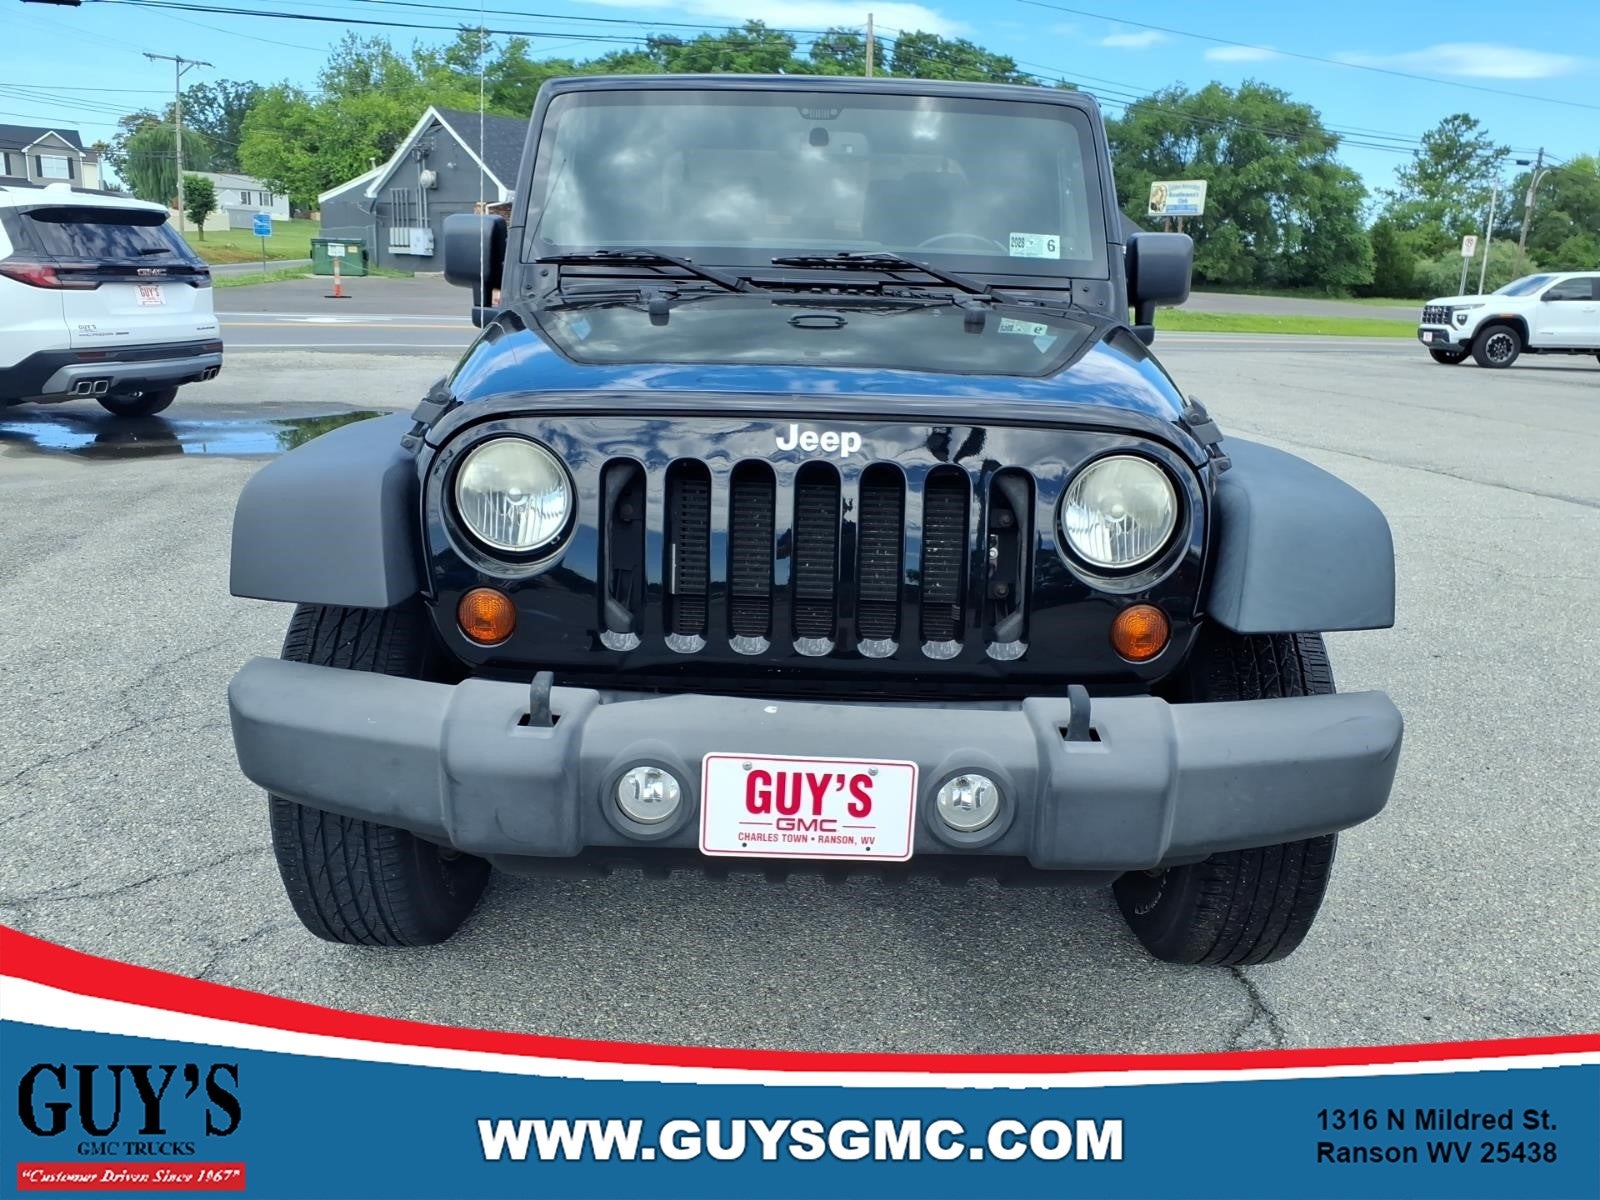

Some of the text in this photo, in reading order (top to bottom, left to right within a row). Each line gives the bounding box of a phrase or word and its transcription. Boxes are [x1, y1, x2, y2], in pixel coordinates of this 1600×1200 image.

[1047, 239, 1056, 252] 6
[140, 287, 160, 297] GUY'S
[776, 424, 862, 458] Jeep
[746, 770, 873, 818] GUY'S
[776, 818, 837, 832] GMC
[738, 832, 876, 846] CHARLES TOWN RANSON, WV
